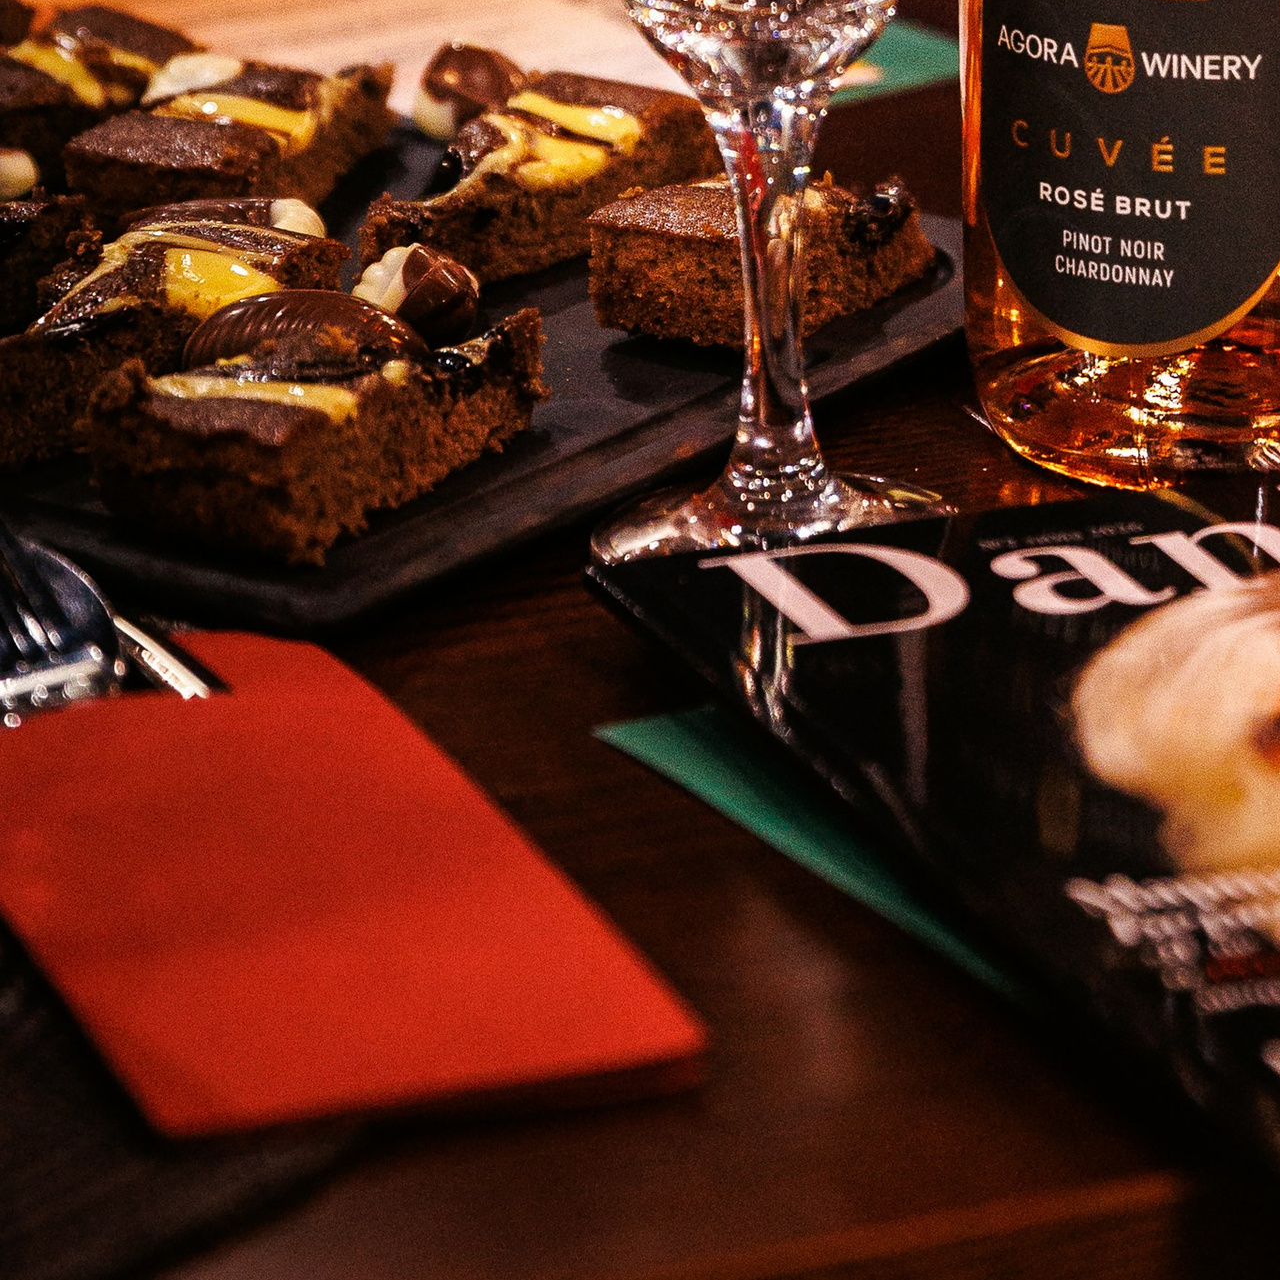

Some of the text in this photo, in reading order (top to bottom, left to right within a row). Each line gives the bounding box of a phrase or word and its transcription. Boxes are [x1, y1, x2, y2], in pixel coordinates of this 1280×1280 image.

[998, 24, 1262, 81] AGORA WINERY
[1011, 119, 1227, 175] CUVÉE
[1039, 181, 1192, 221] ROSÉ BRUT
[1062, 229, 1166, 262] PINOT NOIR
[1055, 255, 1175, 289] CHARDONNAY
